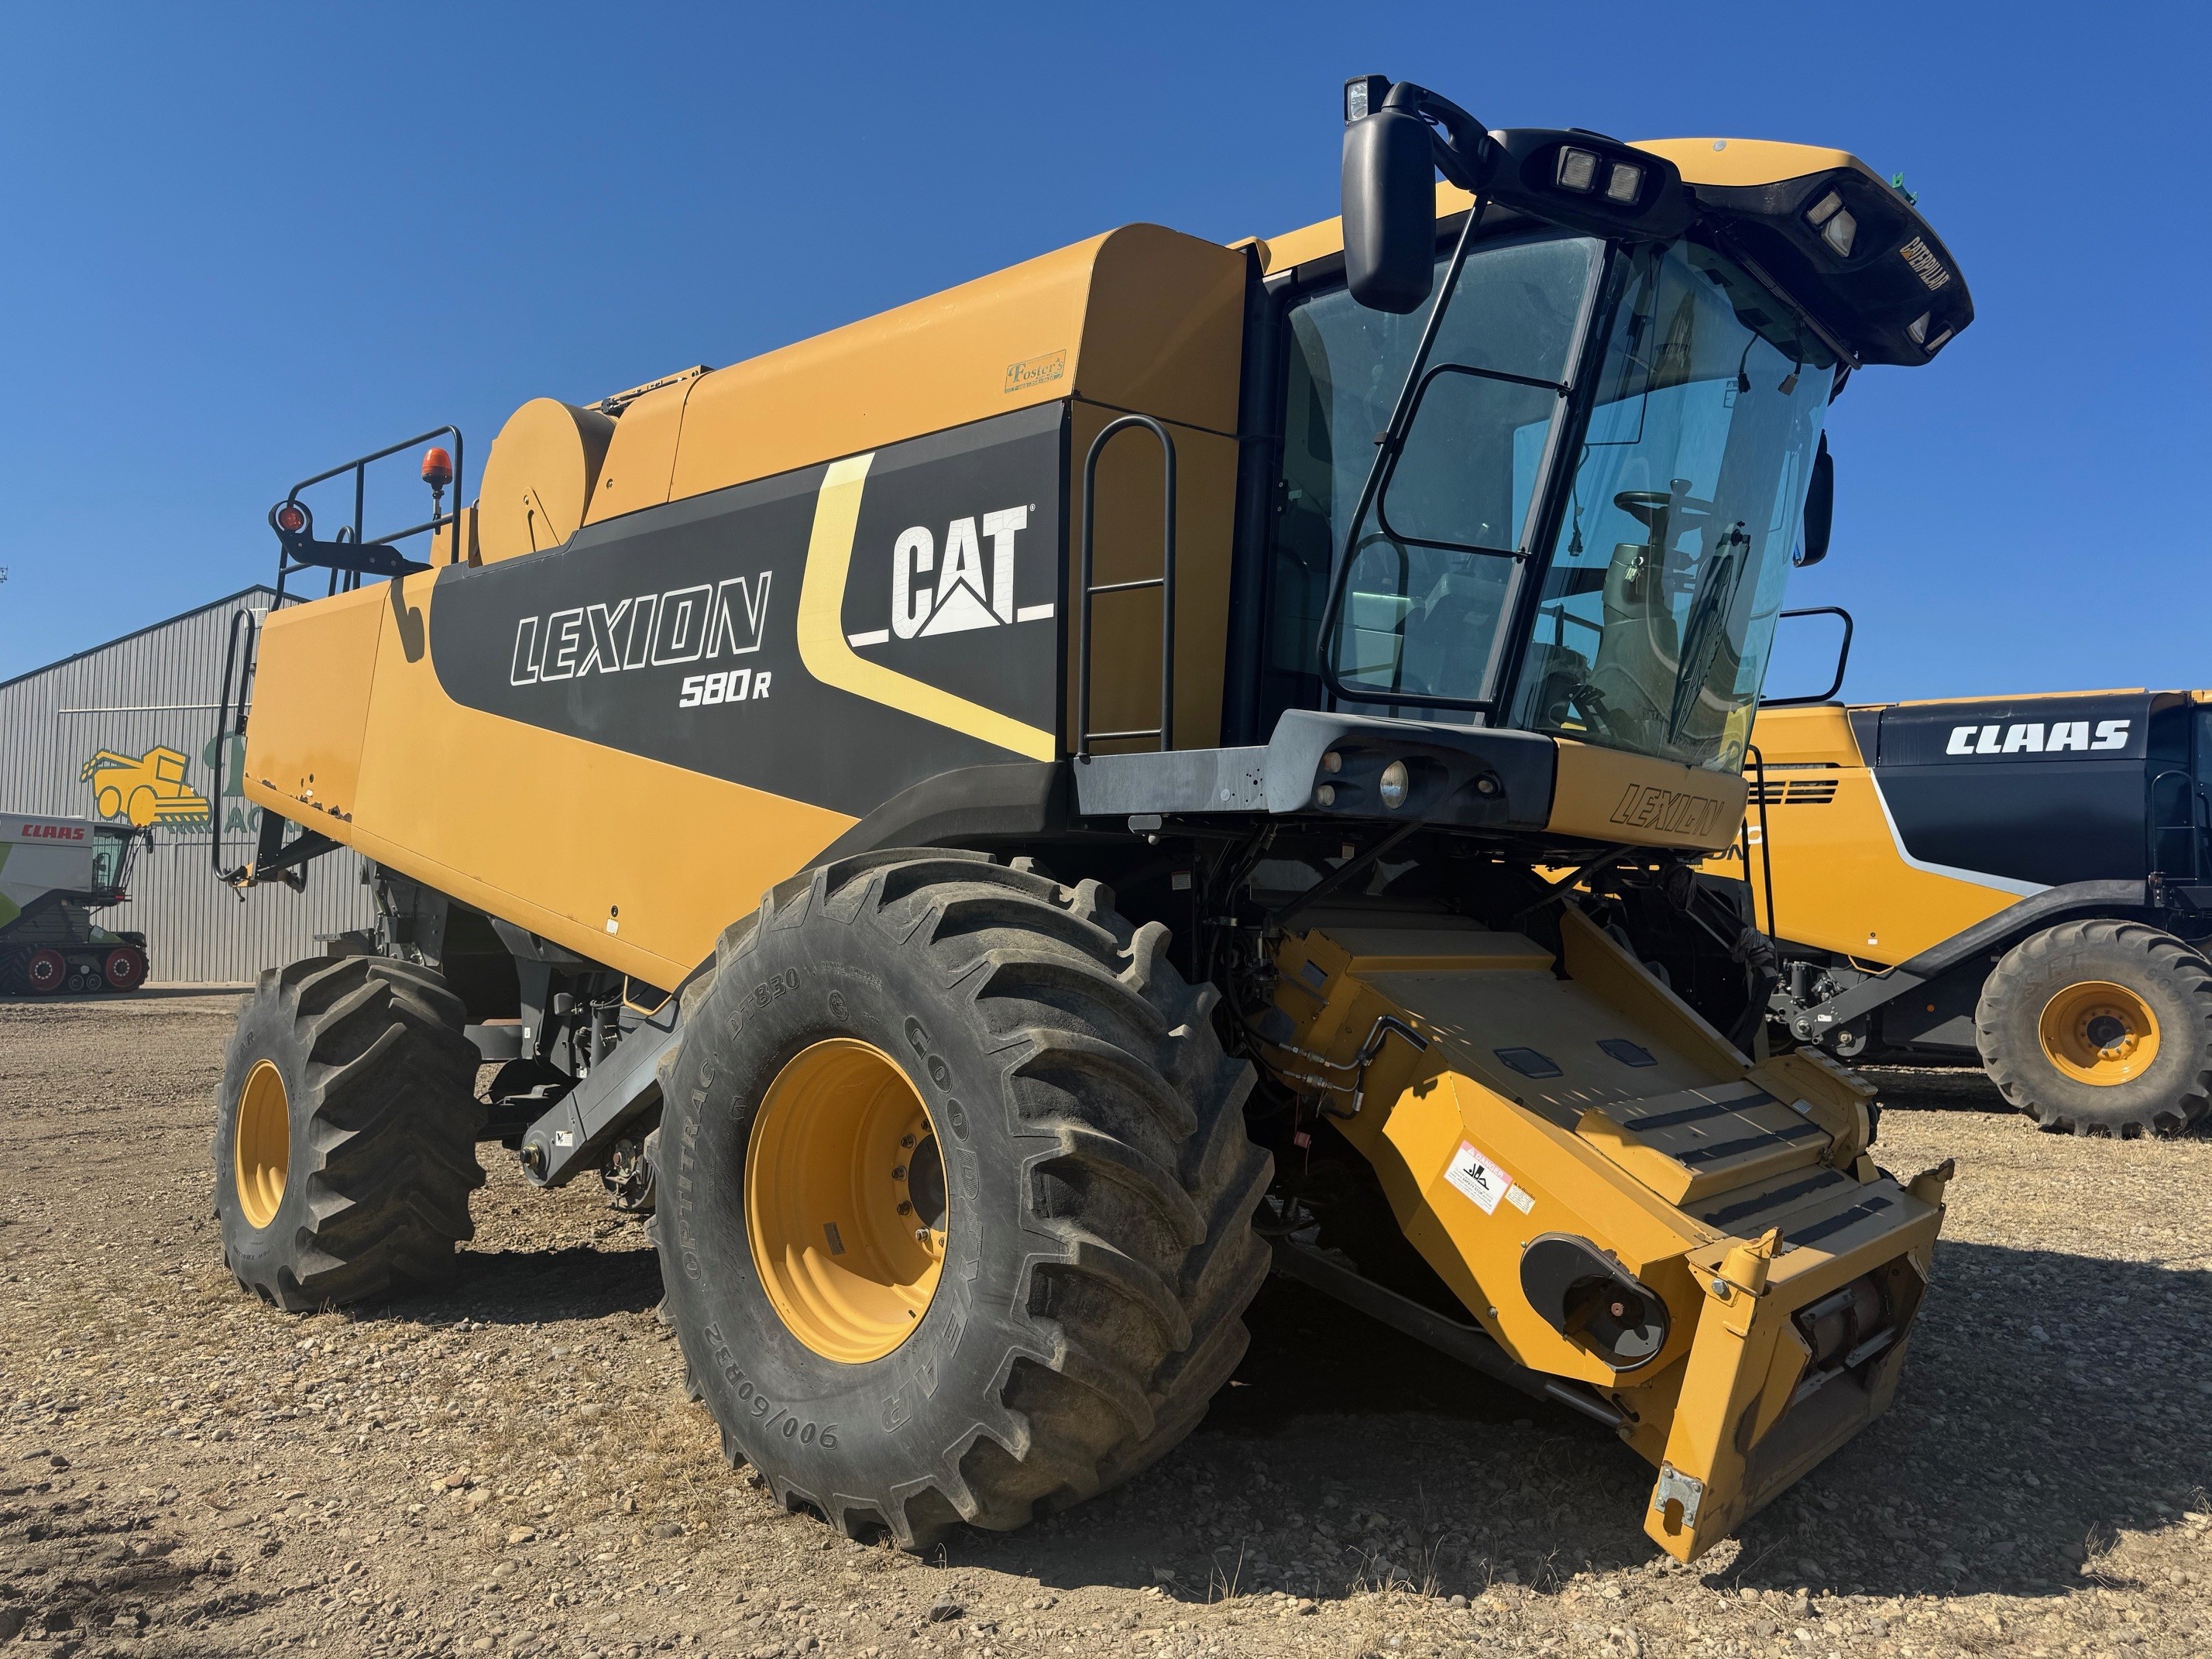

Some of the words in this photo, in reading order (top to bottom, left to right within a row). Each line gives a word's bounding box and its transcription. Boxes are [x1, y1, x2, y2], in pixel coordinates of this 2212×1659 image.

[1899, 235, 1950, 291] CATERPILLAR
[892, 504, 1029, 641] CAT
[510, 570, 773, 687] LEXION
[1946, 719, 2131, 756] CLAAS
[22, 824, 85, 840] CLAAS
[1609, 783, 1726, 836] LEXION
[725, 967, 802, 1041] DT830
[678, 1059, 716, 1280] OPTITRAC
[1475, 1152, 1504, 1177] DANGER
[881, 1015, 983, 1434] GOODYEAR
[704, 1321, 840, 1451] 900/60R32
